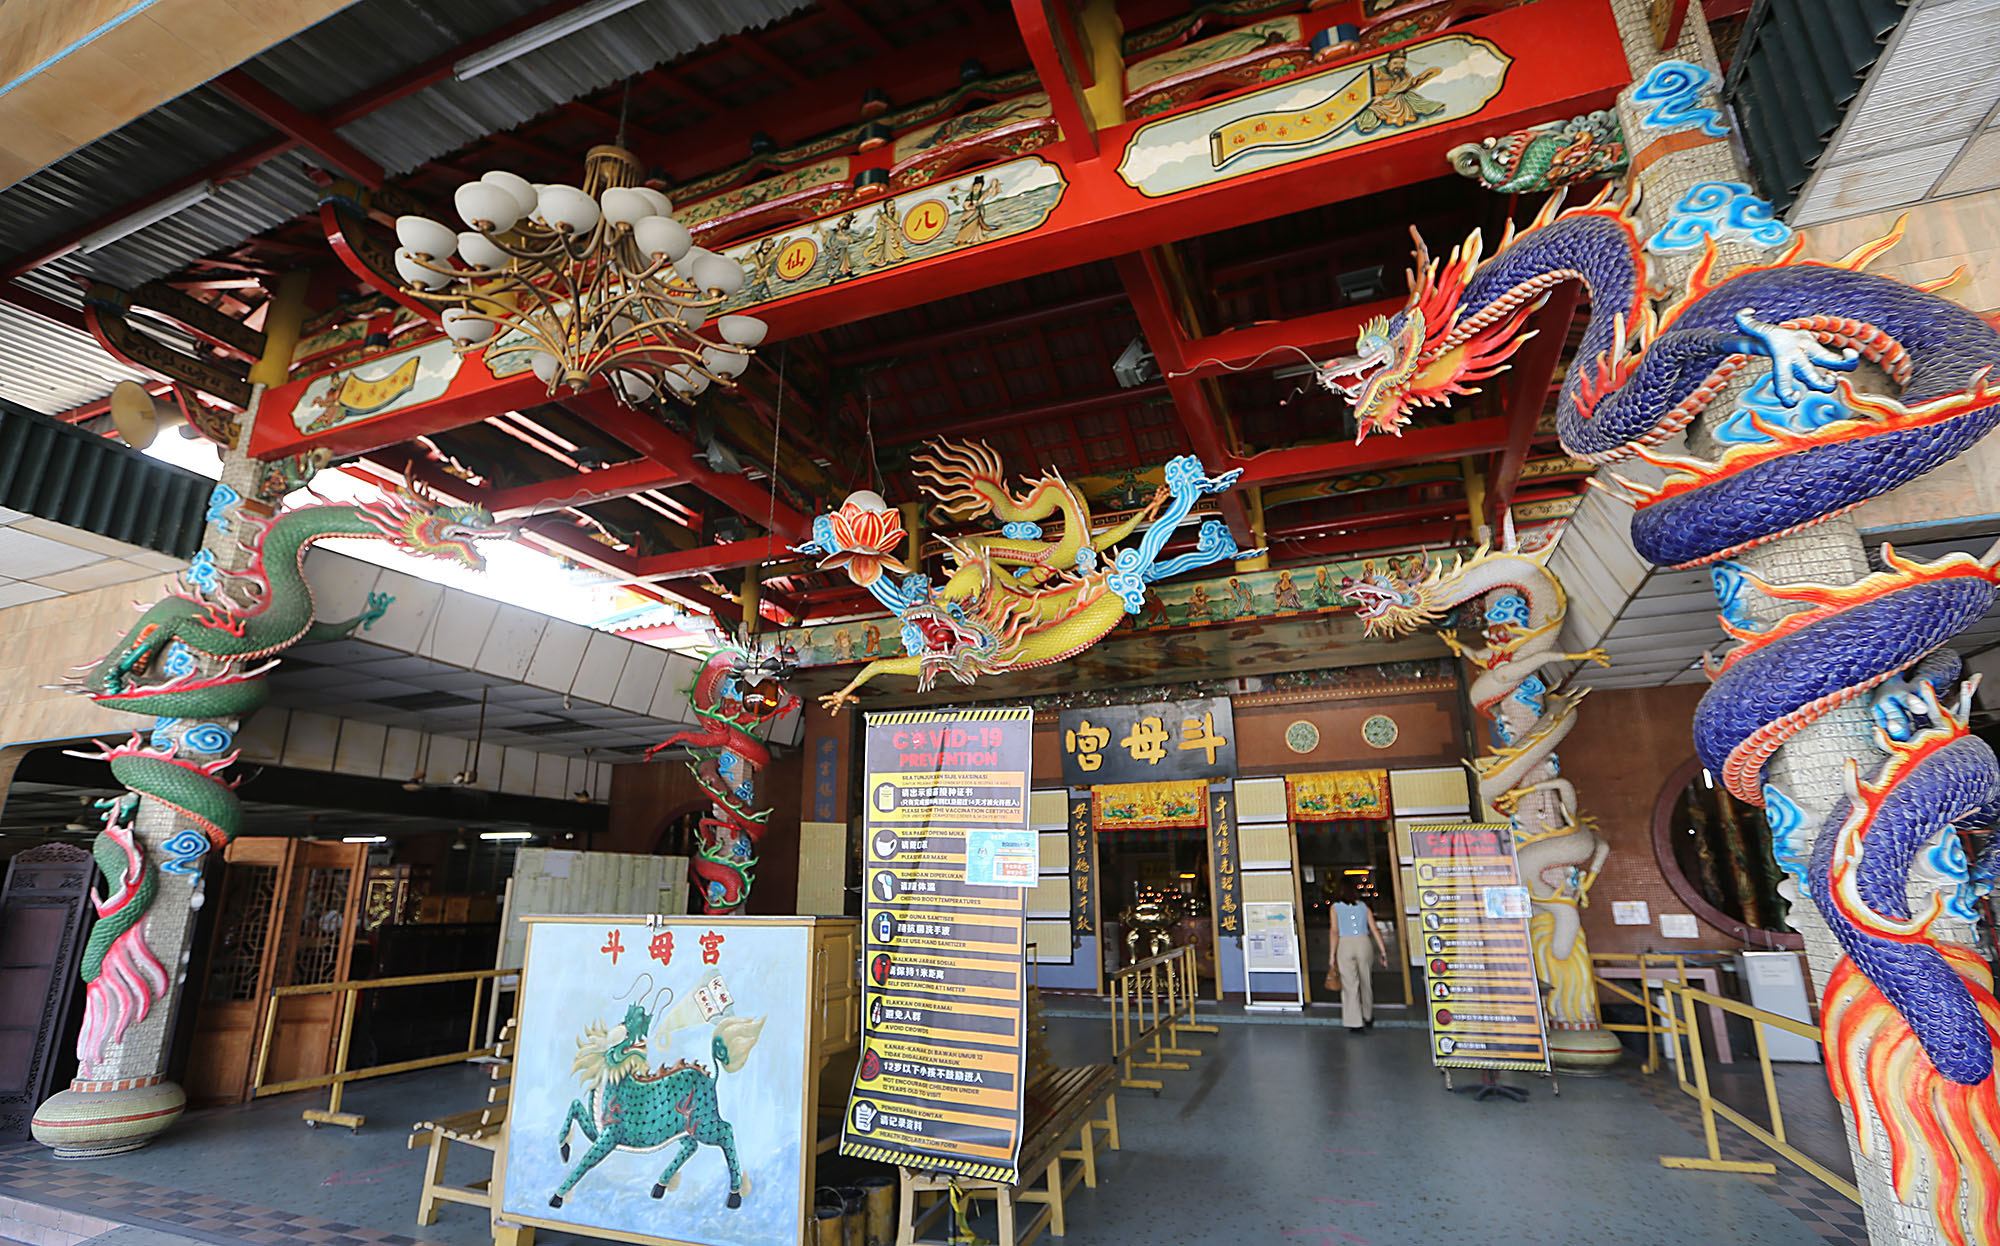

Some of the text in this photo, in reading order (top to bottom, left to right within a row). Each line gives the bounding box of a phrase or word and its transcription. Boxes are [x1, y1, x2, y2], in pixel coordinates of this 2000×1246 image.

[914, 211, 938, 232] 八
[900, 751, 998, 767] PREVENTION
[900, 981, 934, 990] DISTANCING
[885, 1009, 922, 1022] 避免人群
[884, 1024, 929, 1034] AVOID CROWDS
[888, 1085, 906, 1093] YEARS
[928, 1083, 958, 1092] CHILDREN
